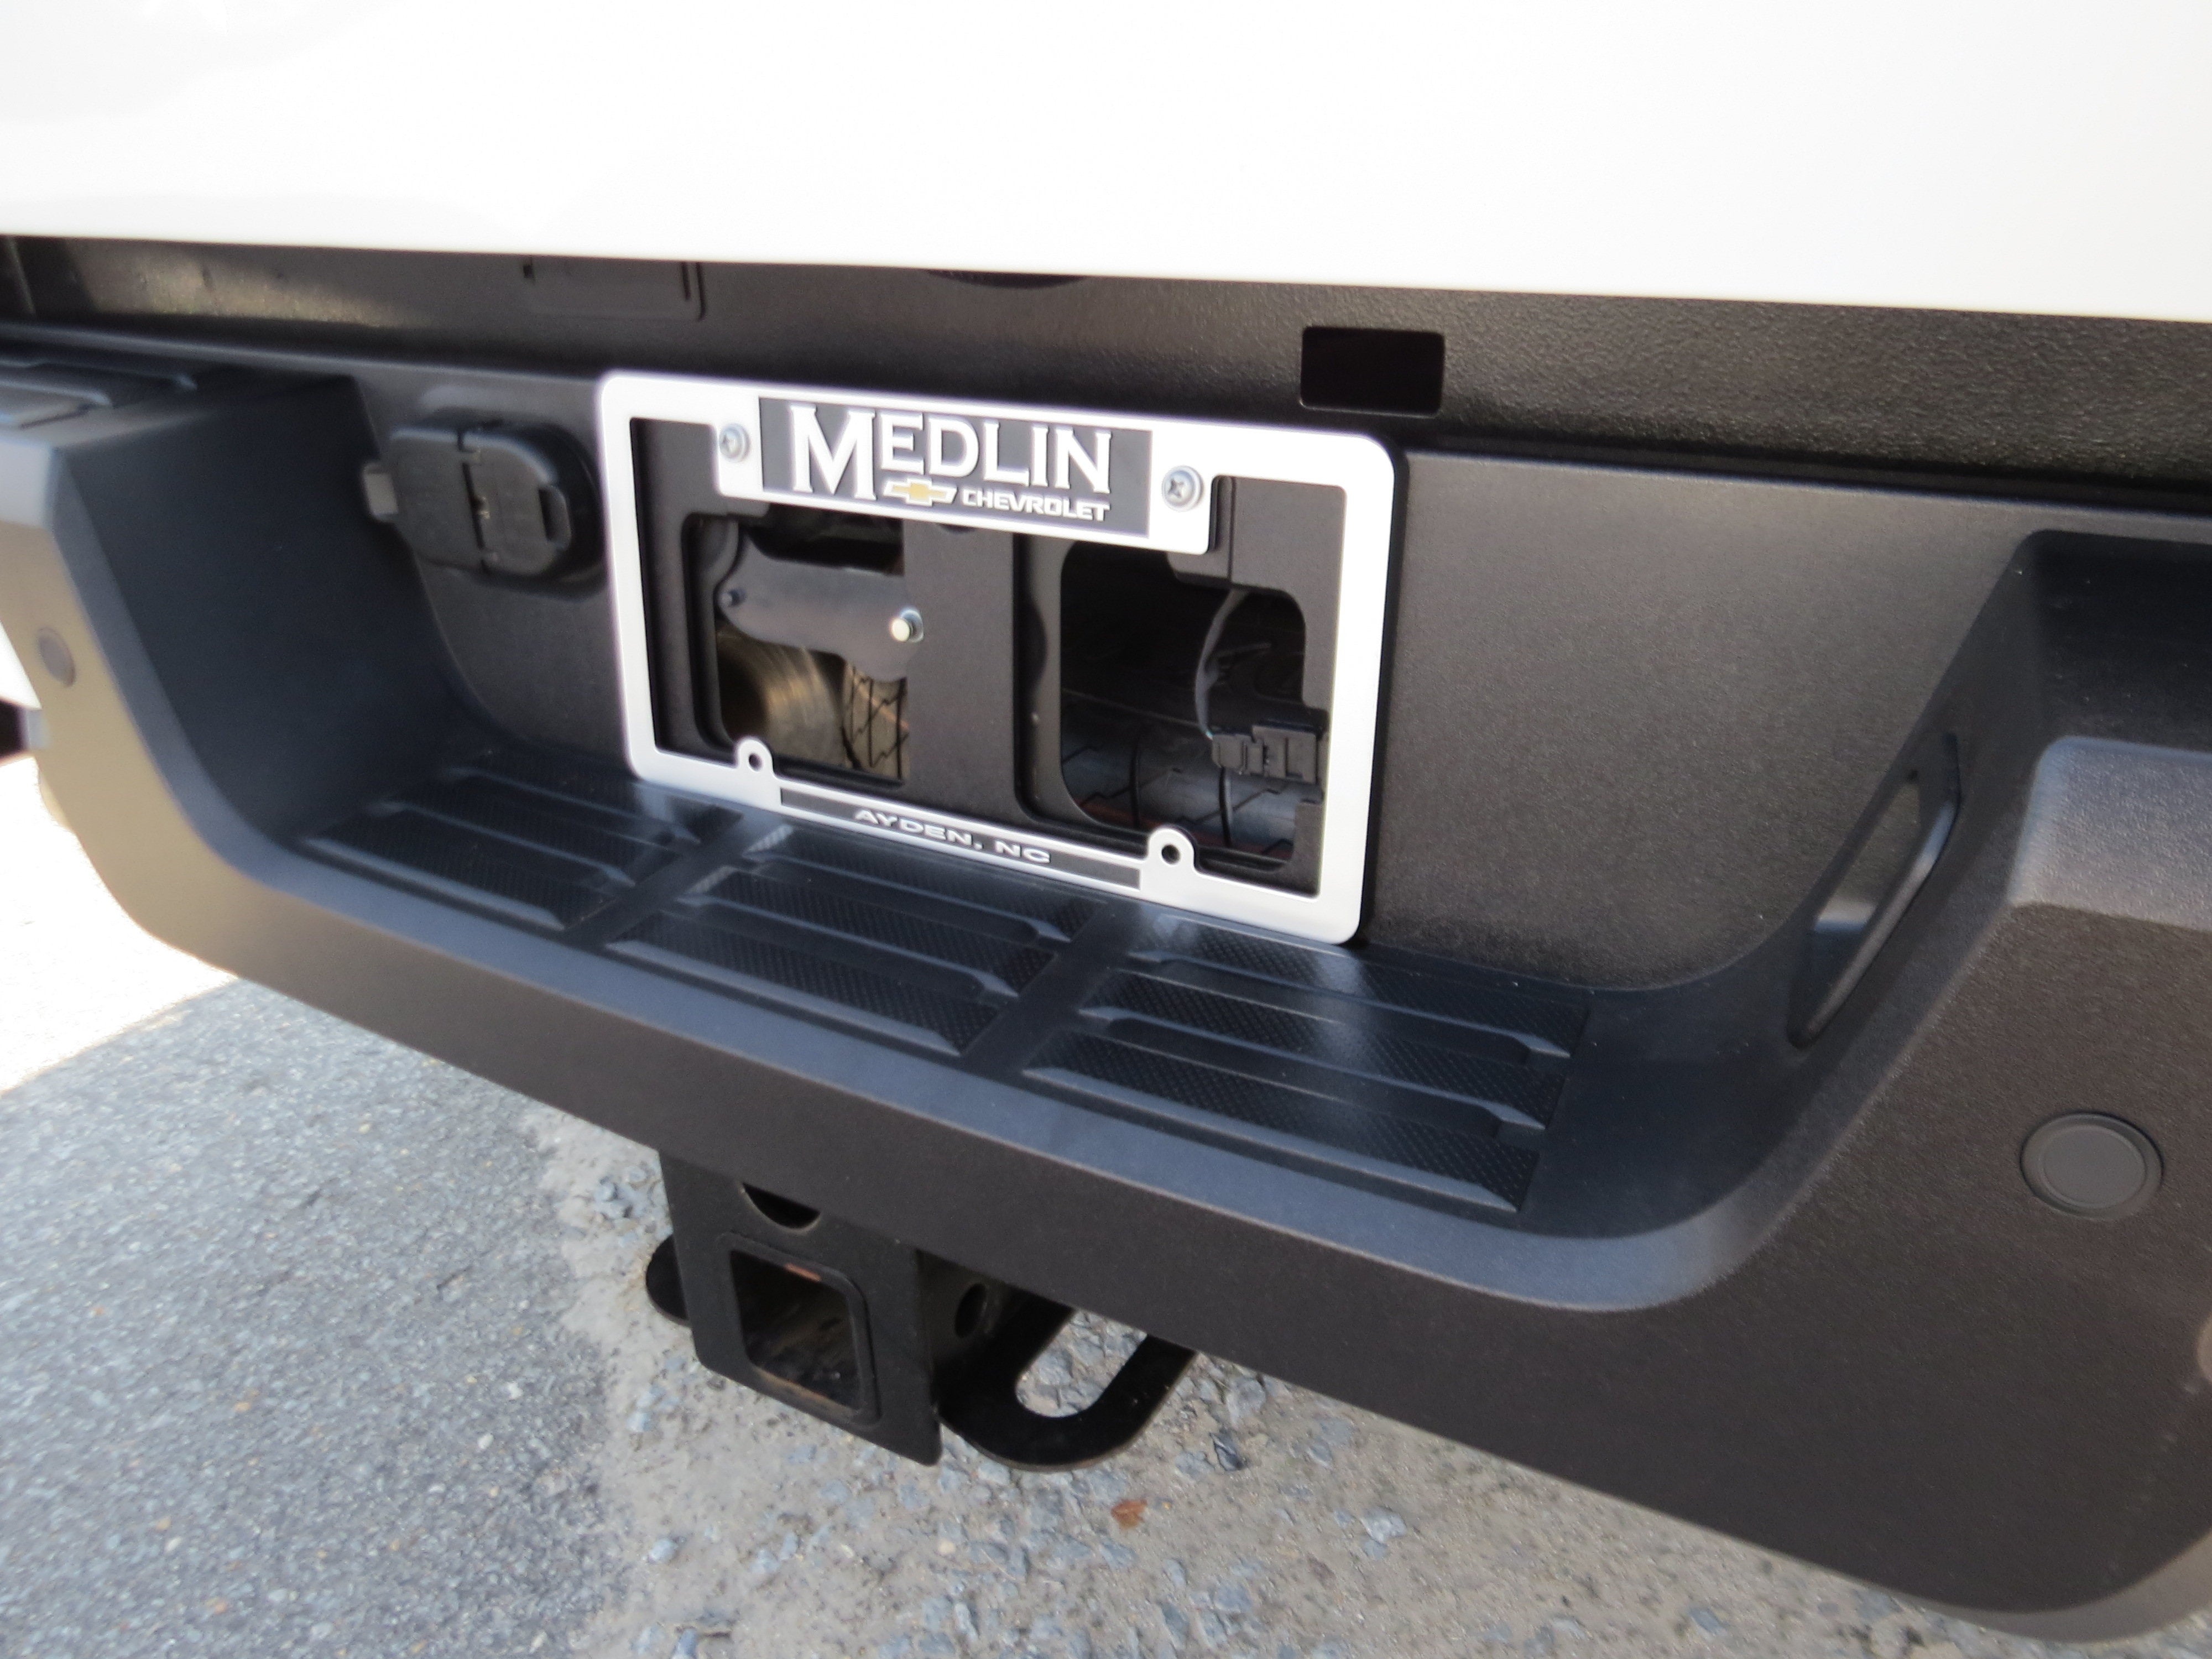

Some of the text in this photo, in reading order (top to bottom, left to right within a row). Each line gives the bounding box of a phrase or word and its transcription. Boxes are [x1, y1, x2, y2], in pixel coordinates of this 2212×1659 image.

[789, 403, 1112, 500] MEDLIN
[962, 487, 1111, 521] CHEVROLET
[995, 841, 1051, 863] NC
